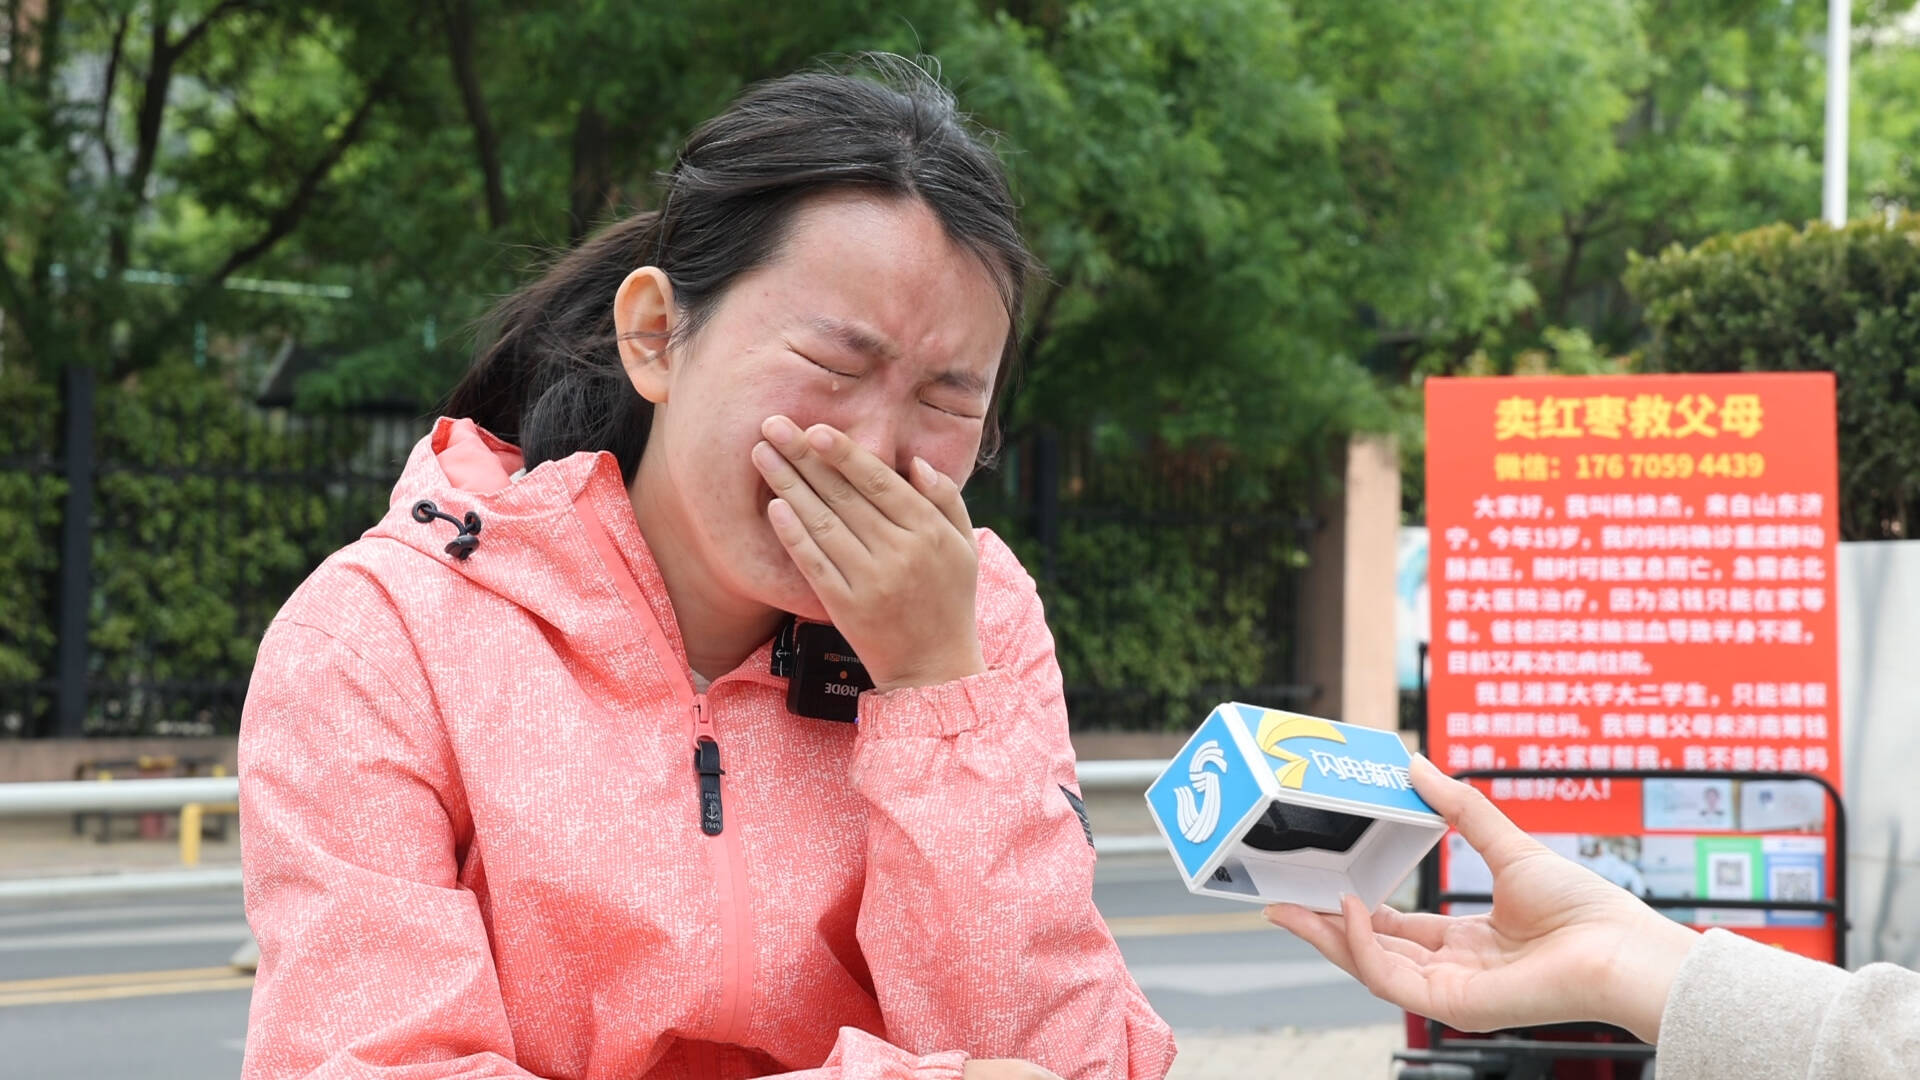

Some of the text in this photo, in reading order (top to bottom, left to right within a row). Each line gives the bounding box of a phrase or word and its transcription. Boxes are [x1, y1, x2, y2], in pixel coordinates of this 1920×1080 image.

[1494, 394, 1764, 440] 卖红枣救父母
[1576, 453, 1624, 478] 176
[1629, 453, 1694, 478] 7059
[1697, 452, 1765, 478] 4439
[824, 682, 858, 697] RØDE
